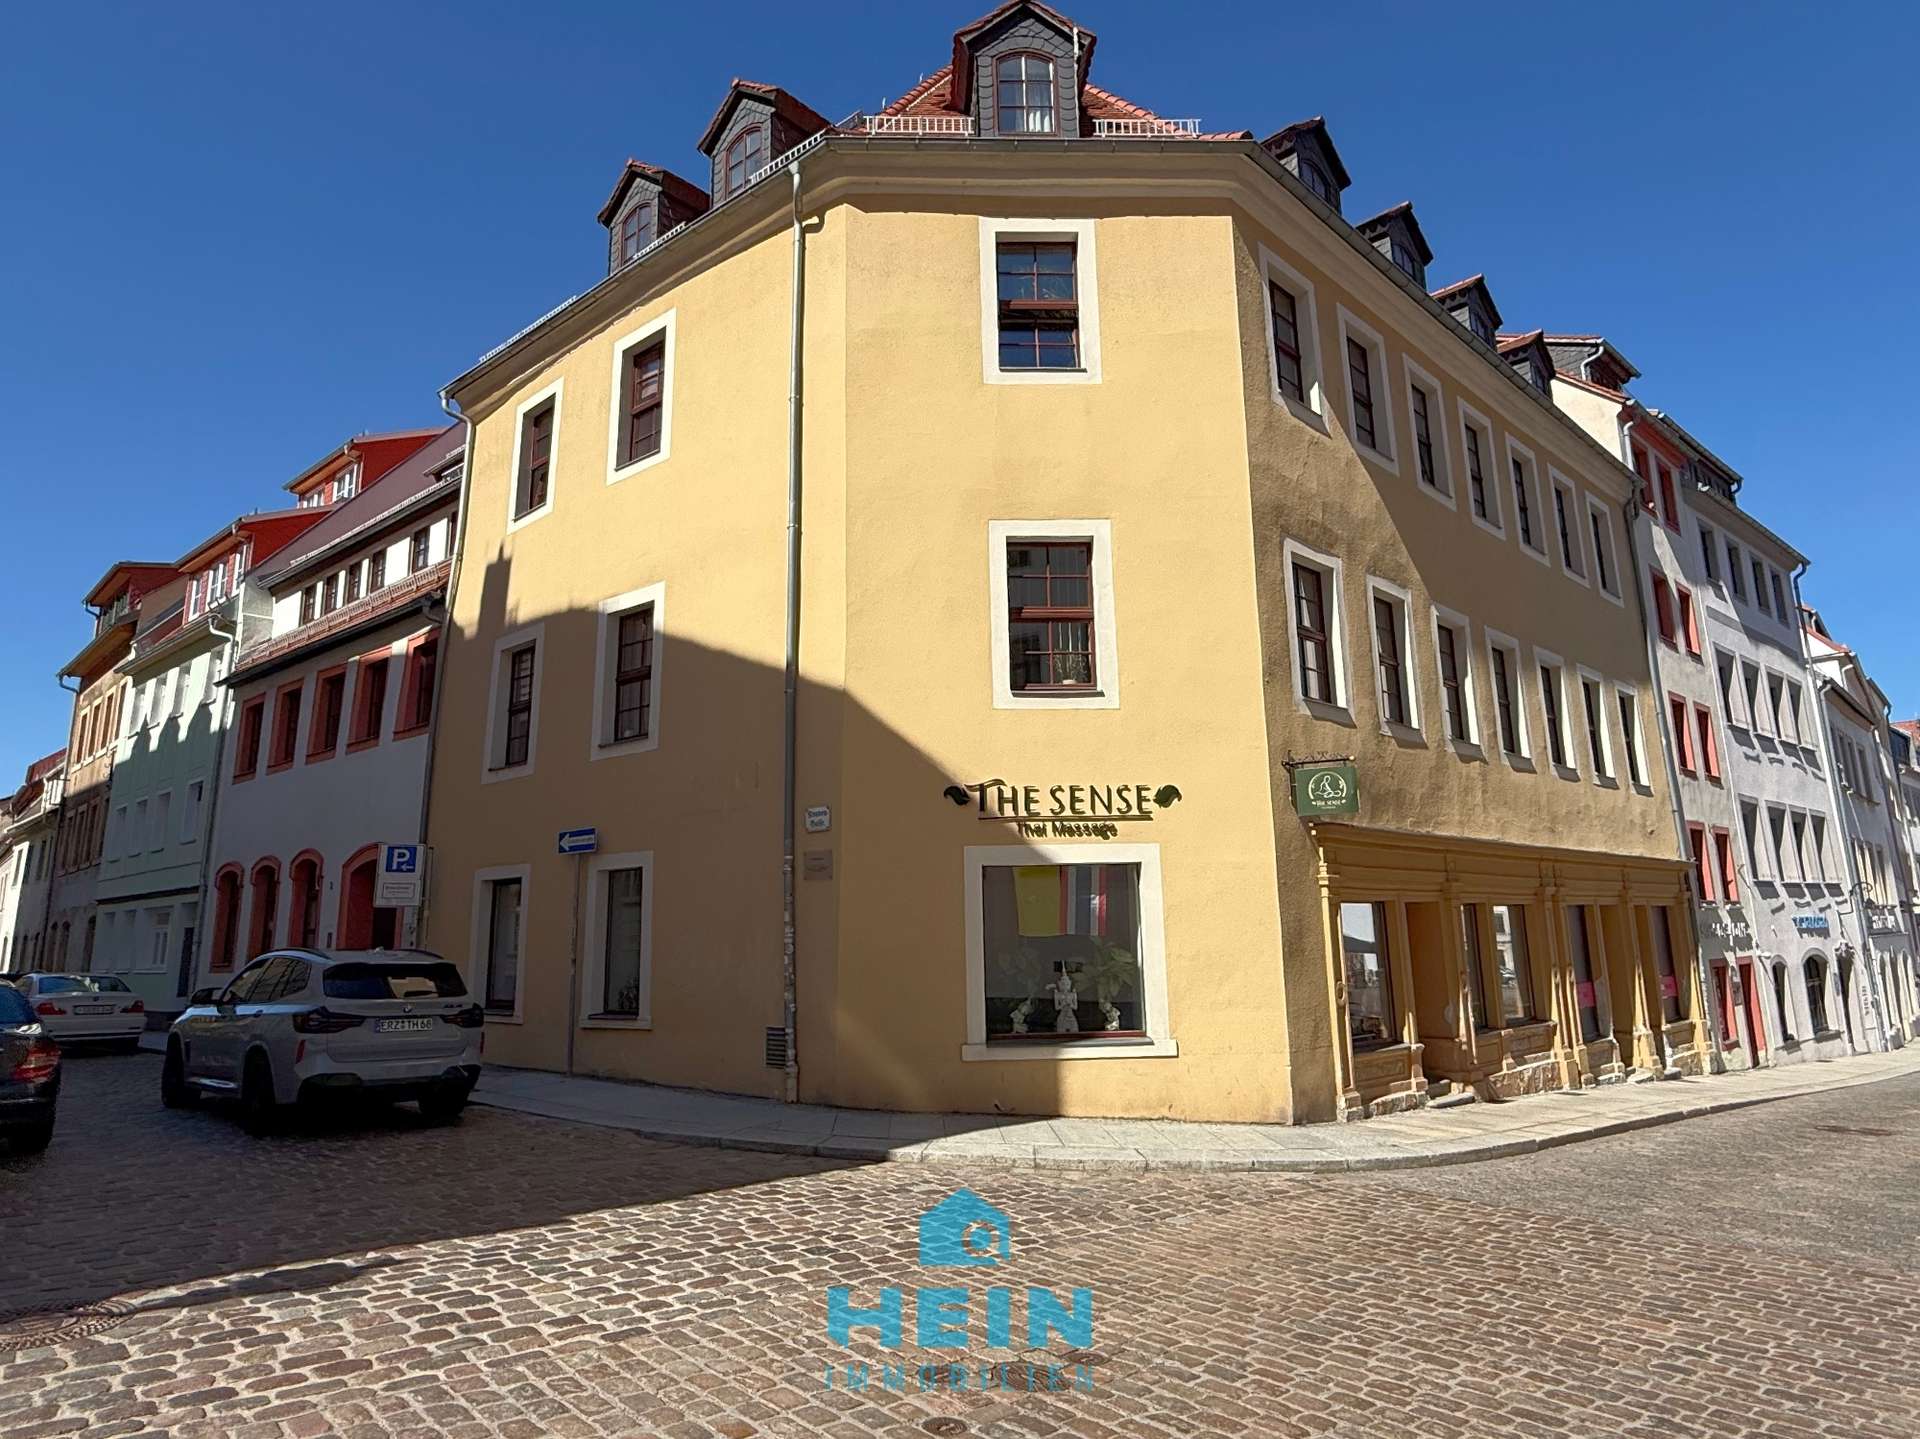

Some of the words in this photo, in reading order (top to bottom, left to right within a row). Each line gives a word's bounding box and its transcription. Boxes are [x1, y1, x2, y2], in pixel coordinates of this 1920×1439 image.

[964, 779, 1041, 816] THE
[1049, 784, 1153, 815] SENSE
[1016, 821, 1047, 838] Thai
[1052, 820, 1118, 840] Massage
[392, 848, 410, 870] P
